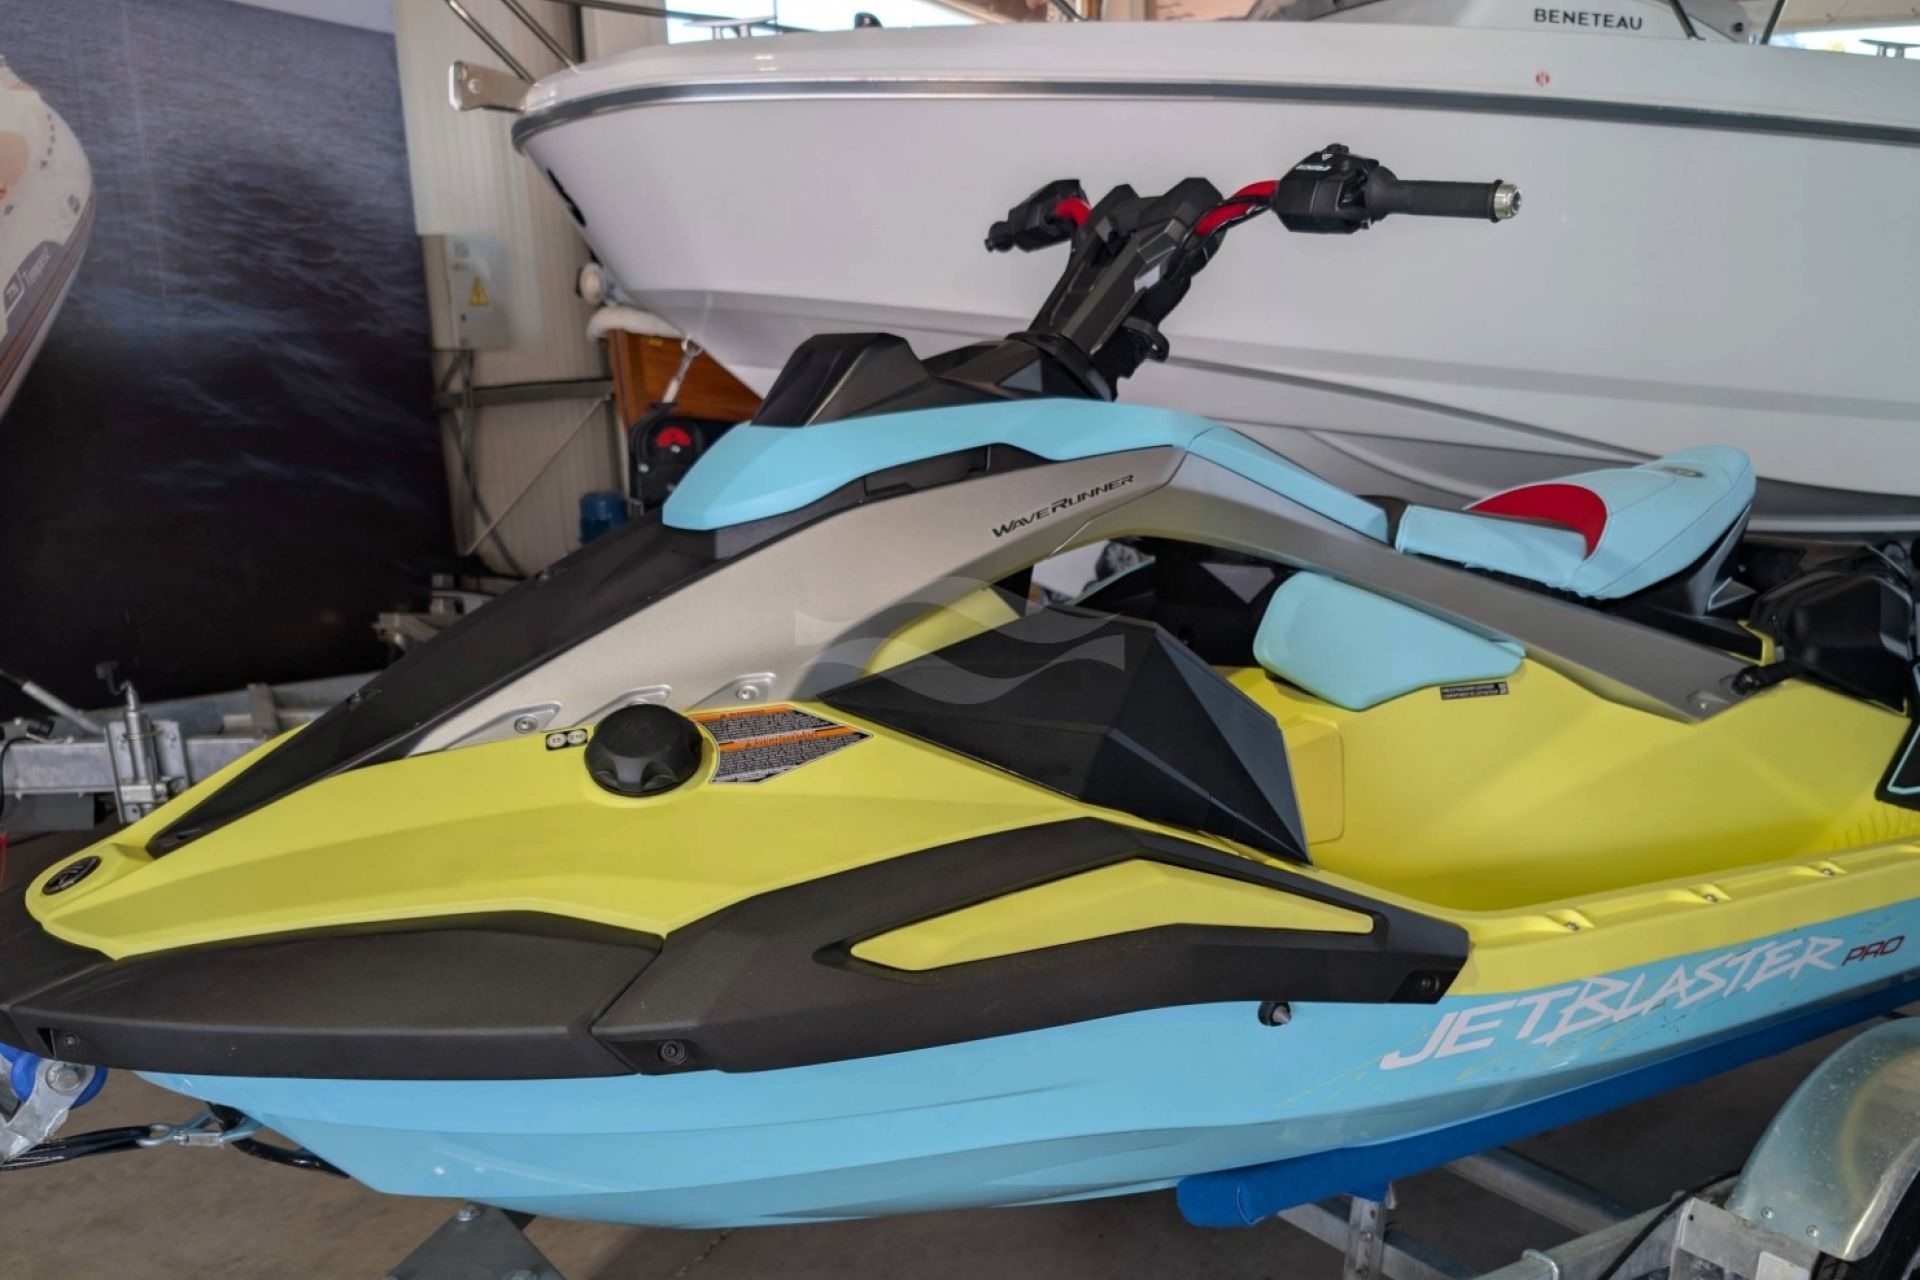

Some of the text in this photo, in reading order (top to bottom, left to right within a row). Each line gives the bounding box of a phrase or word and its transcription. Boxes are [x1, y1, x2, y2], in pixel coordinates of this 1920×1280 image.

[1533, 8, 1643, 30] BENETEAU
[992, 474, 1135, 537] WAVERUNNER
[1841, 935, 1906, 967] PRO
